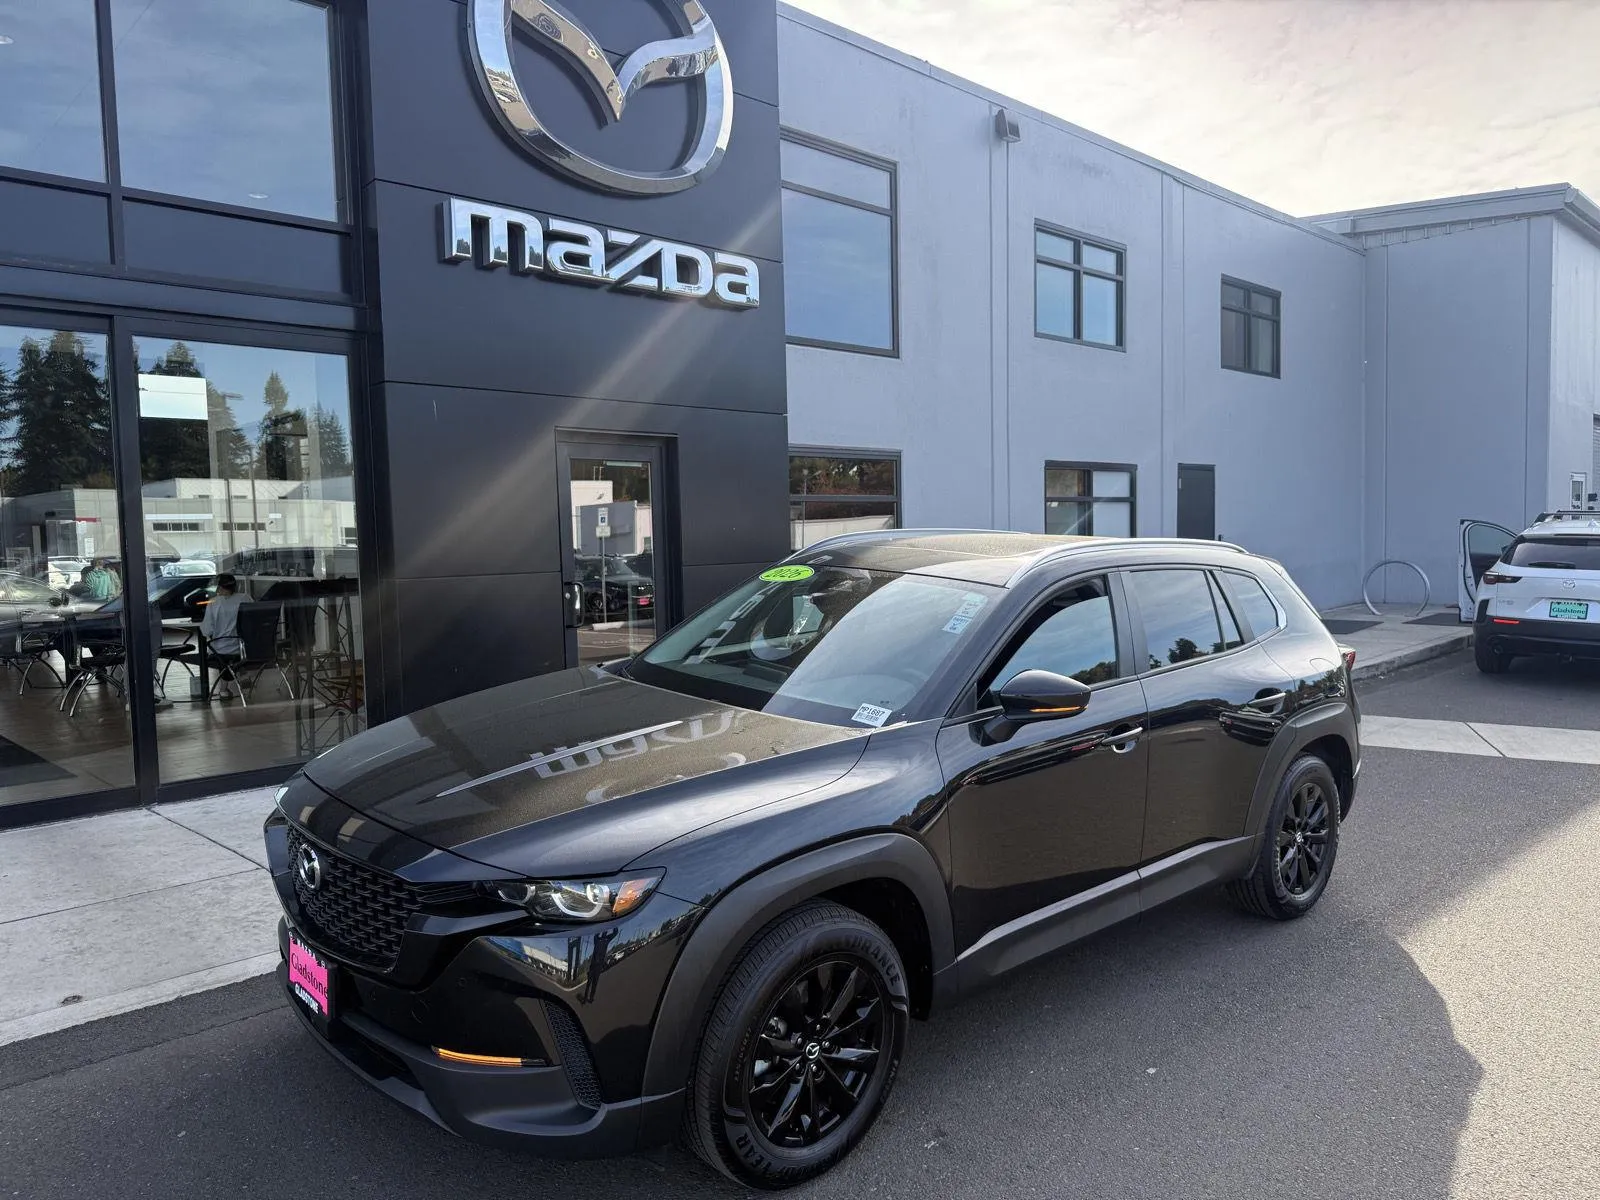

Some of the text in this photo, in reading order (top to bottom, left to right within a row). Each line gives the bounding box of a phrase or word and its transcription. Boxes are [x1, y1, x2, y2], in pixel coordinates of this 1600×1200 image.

[1552, 606, 1586, 615] Gladstone
[858, 705, 886, 718] MP1687
[291, 952, 328, 1000] Gladstone
